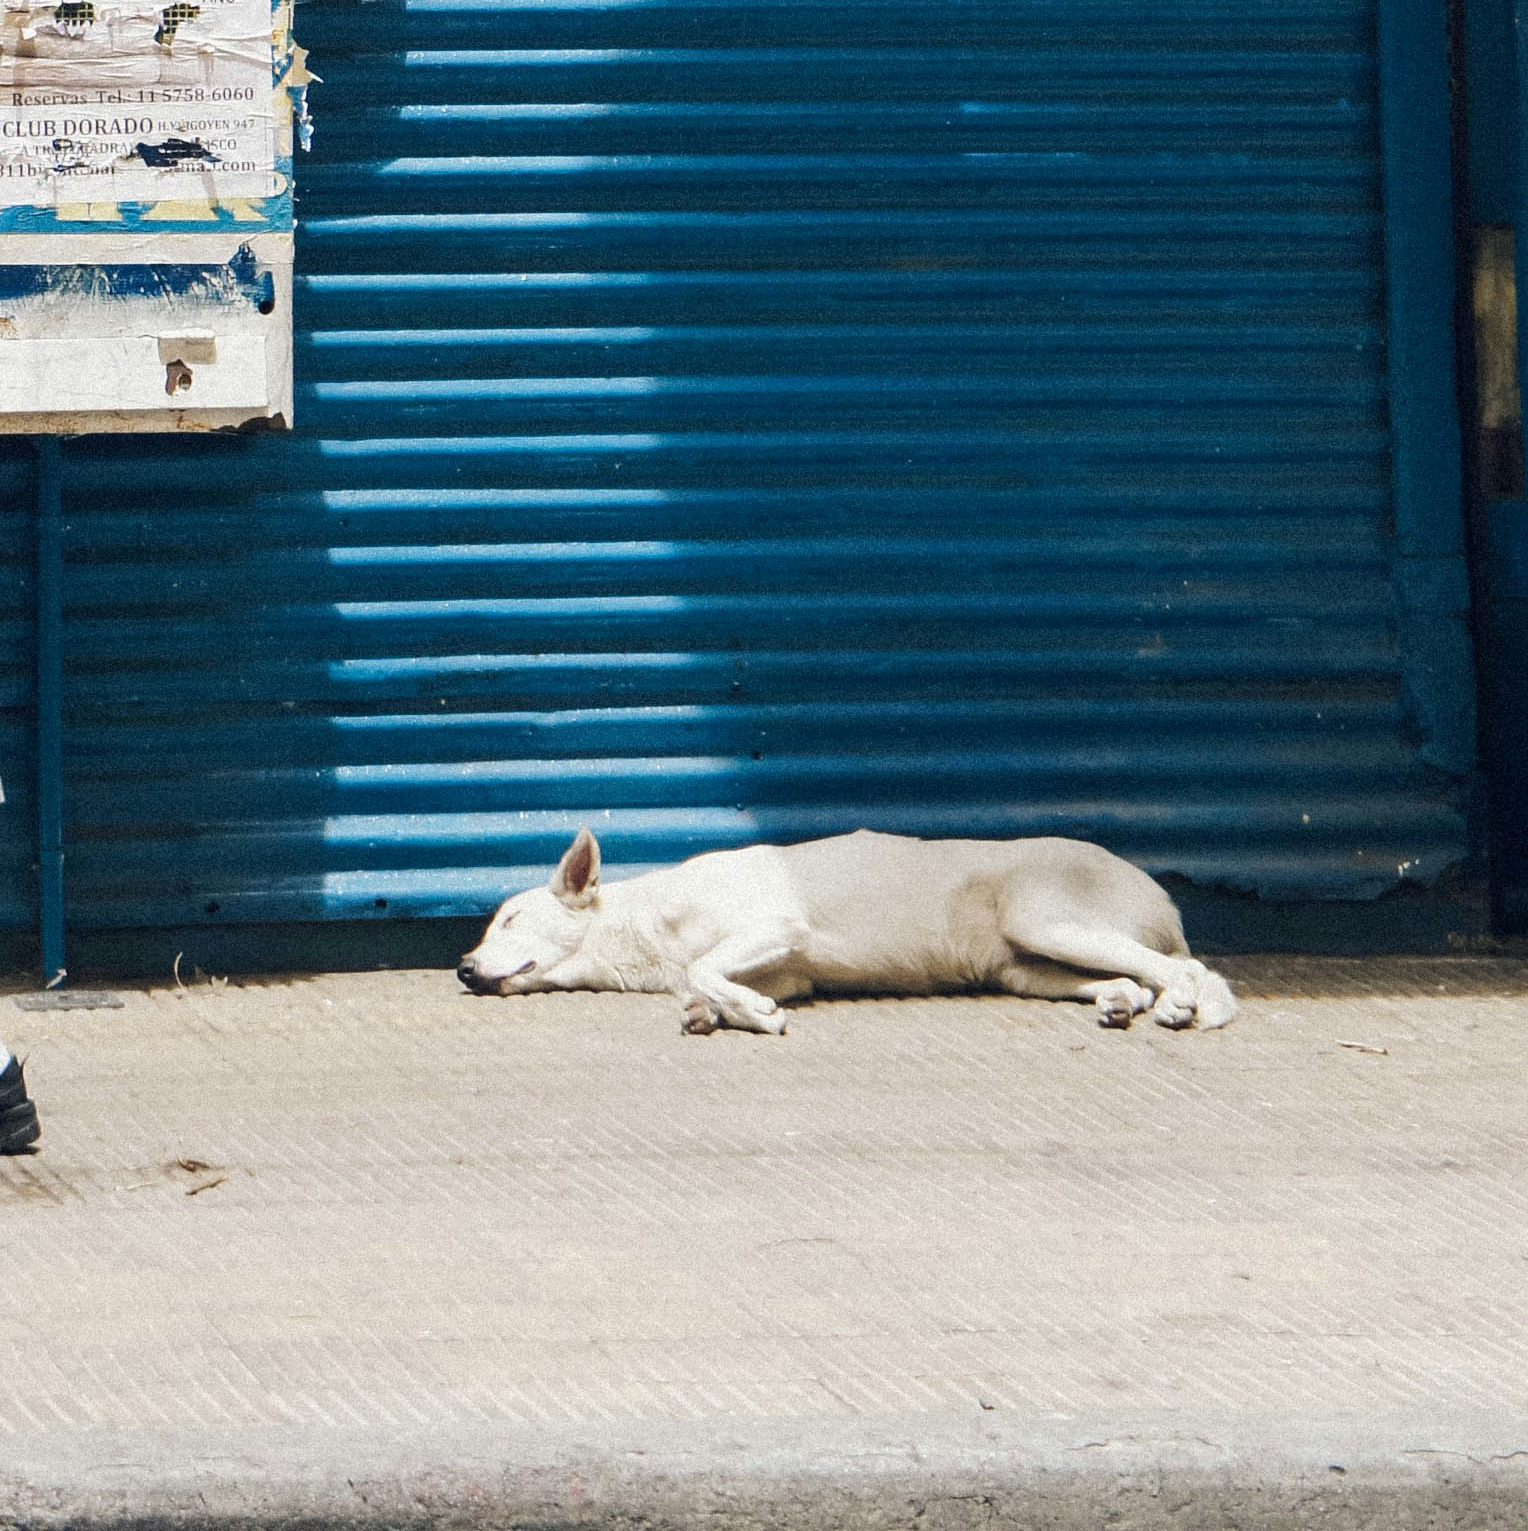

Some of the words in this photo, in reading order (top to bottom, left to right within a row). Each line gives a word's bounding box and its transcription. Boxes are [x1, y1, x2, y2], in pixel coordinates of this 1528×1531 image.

[12, 92, 88, 107] Reservas
[162, 86, 255, 103] 5758-6060
[2, 119, 57, 138] CLUB
[63, 116, 154, 137] DORADO
[233, 119, 256, 130] 947
